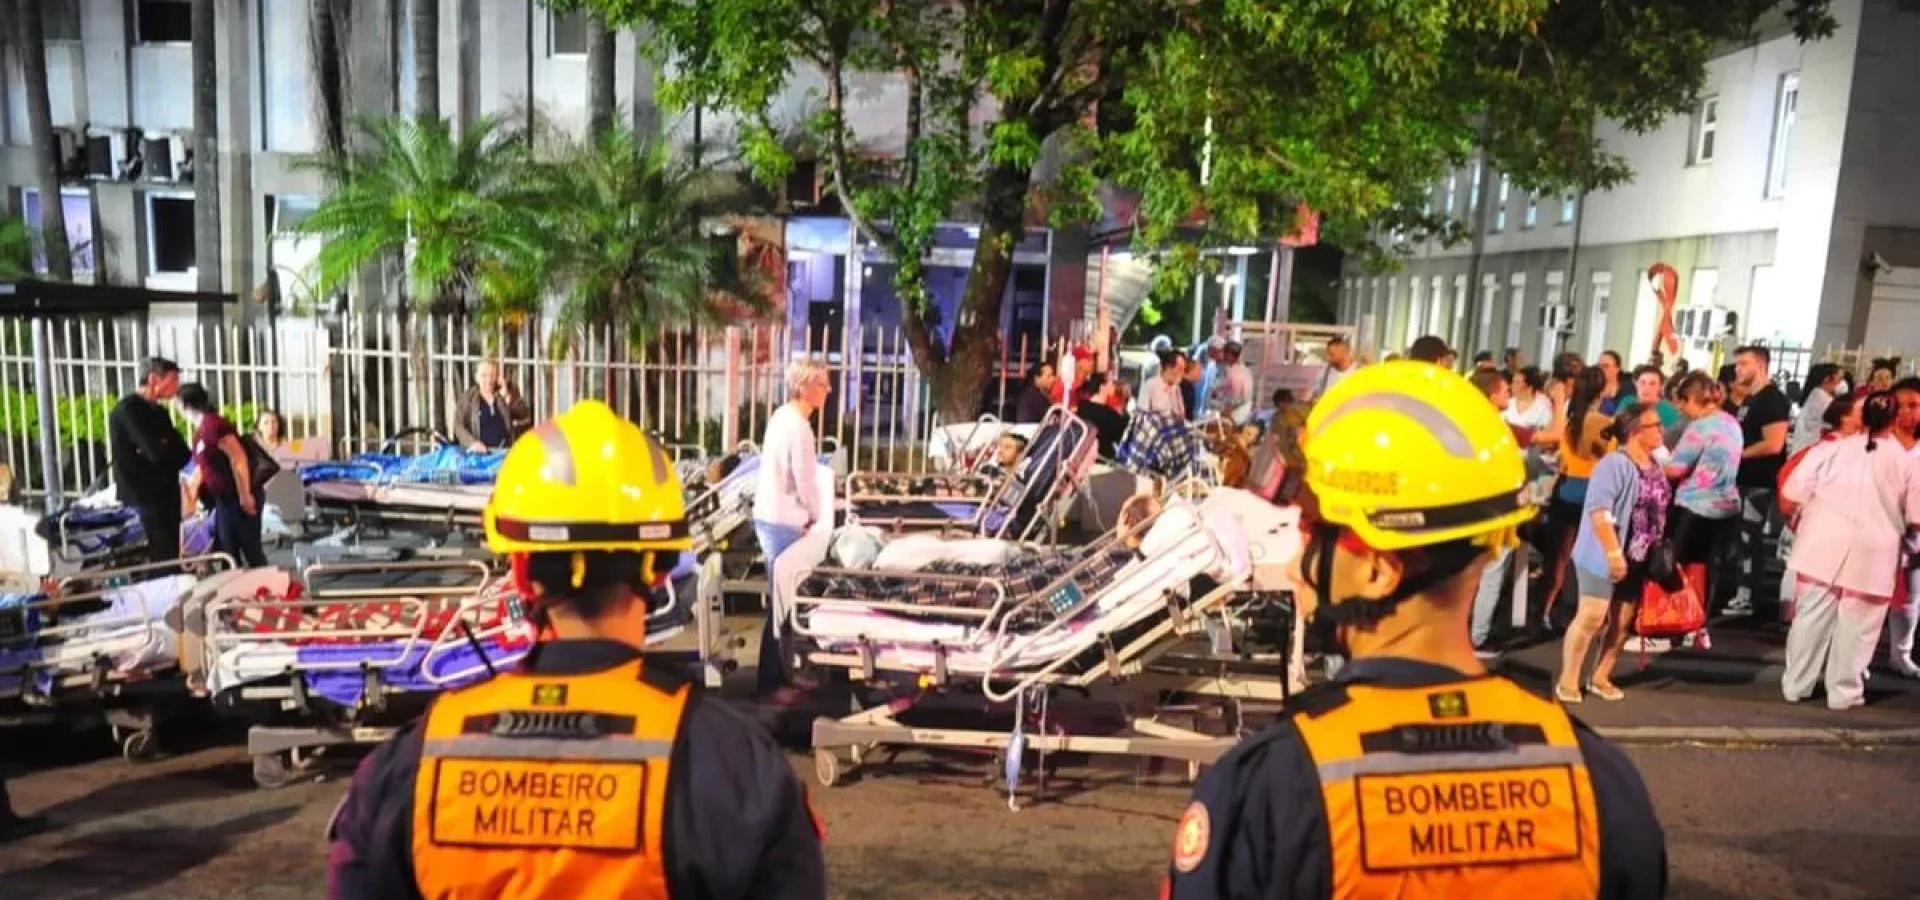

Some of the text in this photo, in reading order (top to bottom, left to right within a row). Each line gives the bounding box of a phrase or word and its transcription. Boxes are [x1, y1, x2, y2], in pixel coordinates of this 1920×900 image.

[459, 769, 617, 801] BOMBEIRO
[1384, 778, 1551, 815] BOMBEIRO
[474, 804, 596, 837] MILITAR
[1410, 819, 1535, 856] MILITAR
